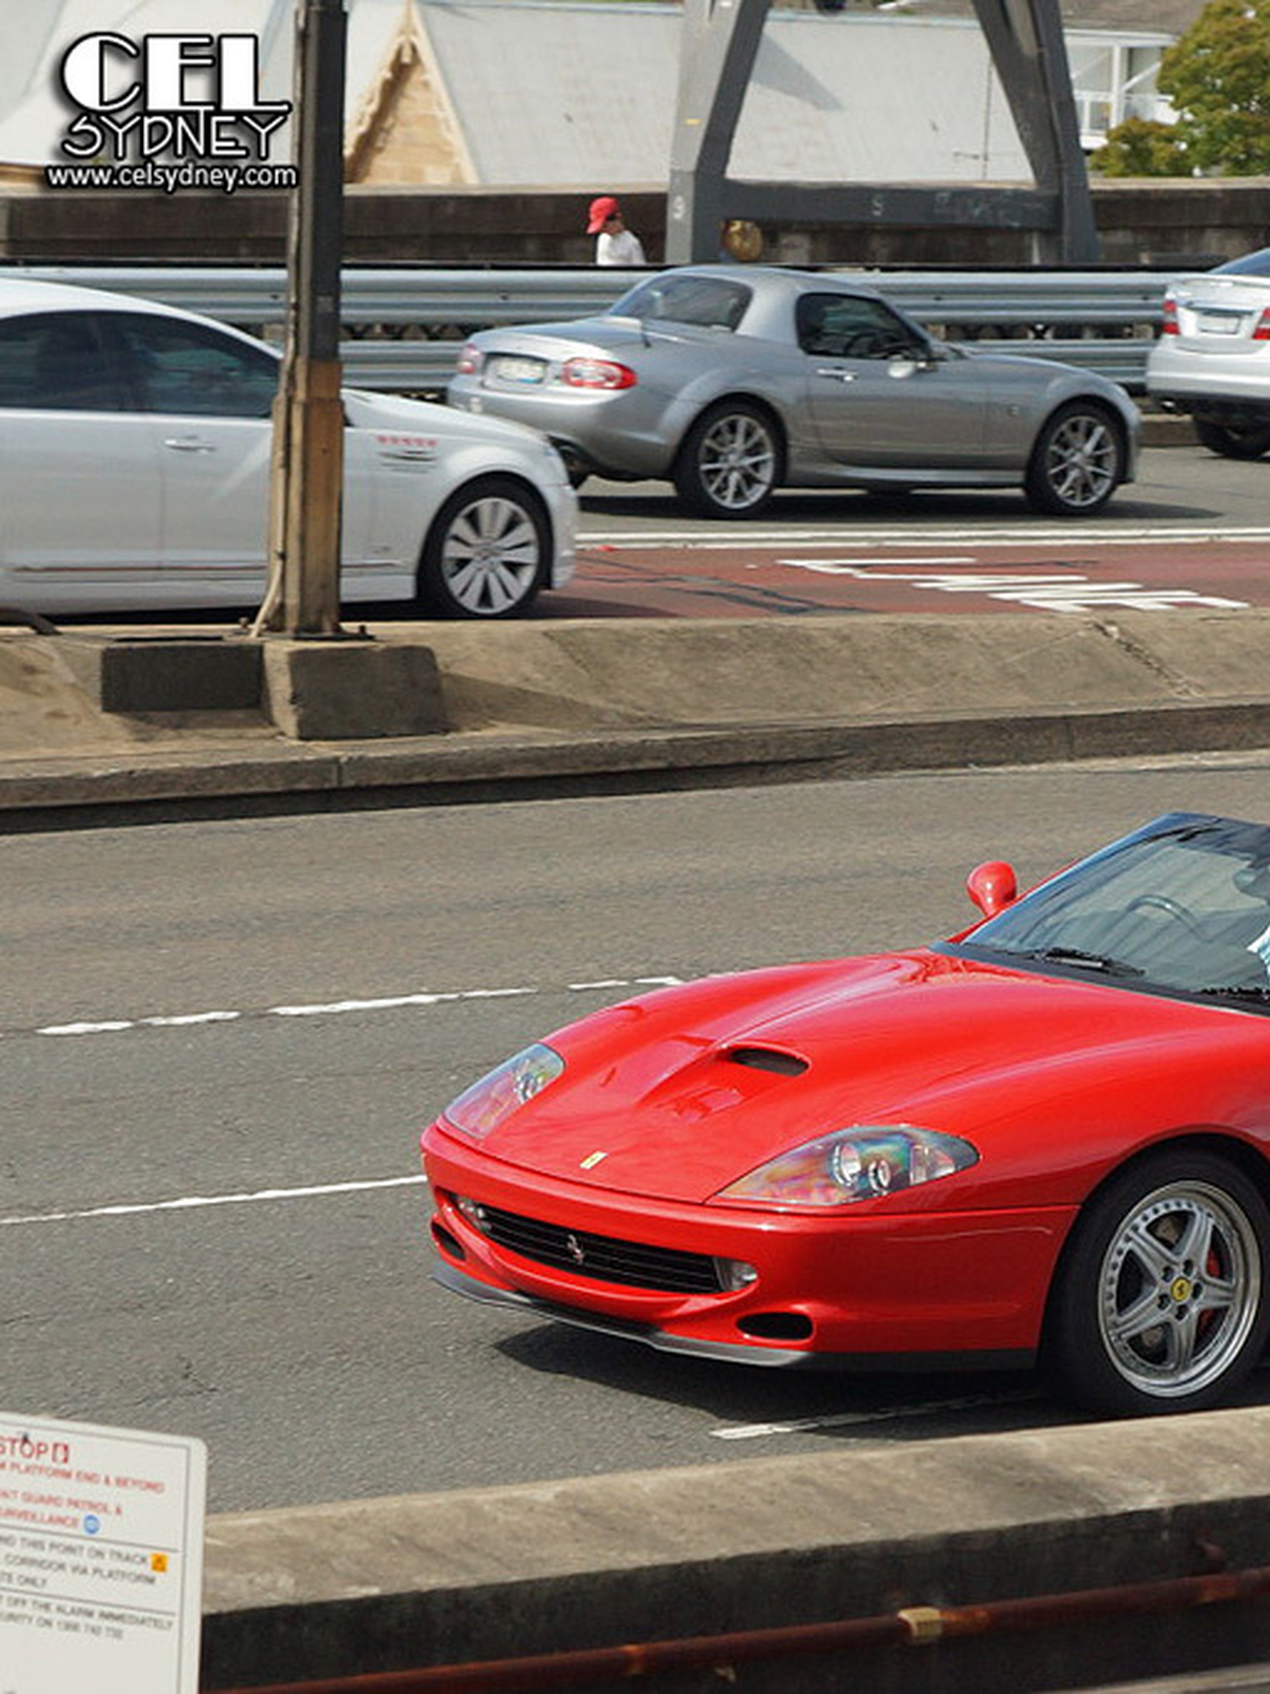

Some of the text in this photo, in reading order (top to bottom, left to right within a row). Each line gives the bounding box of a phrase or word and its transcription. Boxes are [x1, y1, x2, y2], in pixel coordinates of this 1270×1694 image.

[777, 557, 1249, 612] LANE
[10, 1463, 72, 1479] PLATFORM
[76, 1471, 101, 1484] END
[0, 1509, 78, 1528] URVEILLANCE
